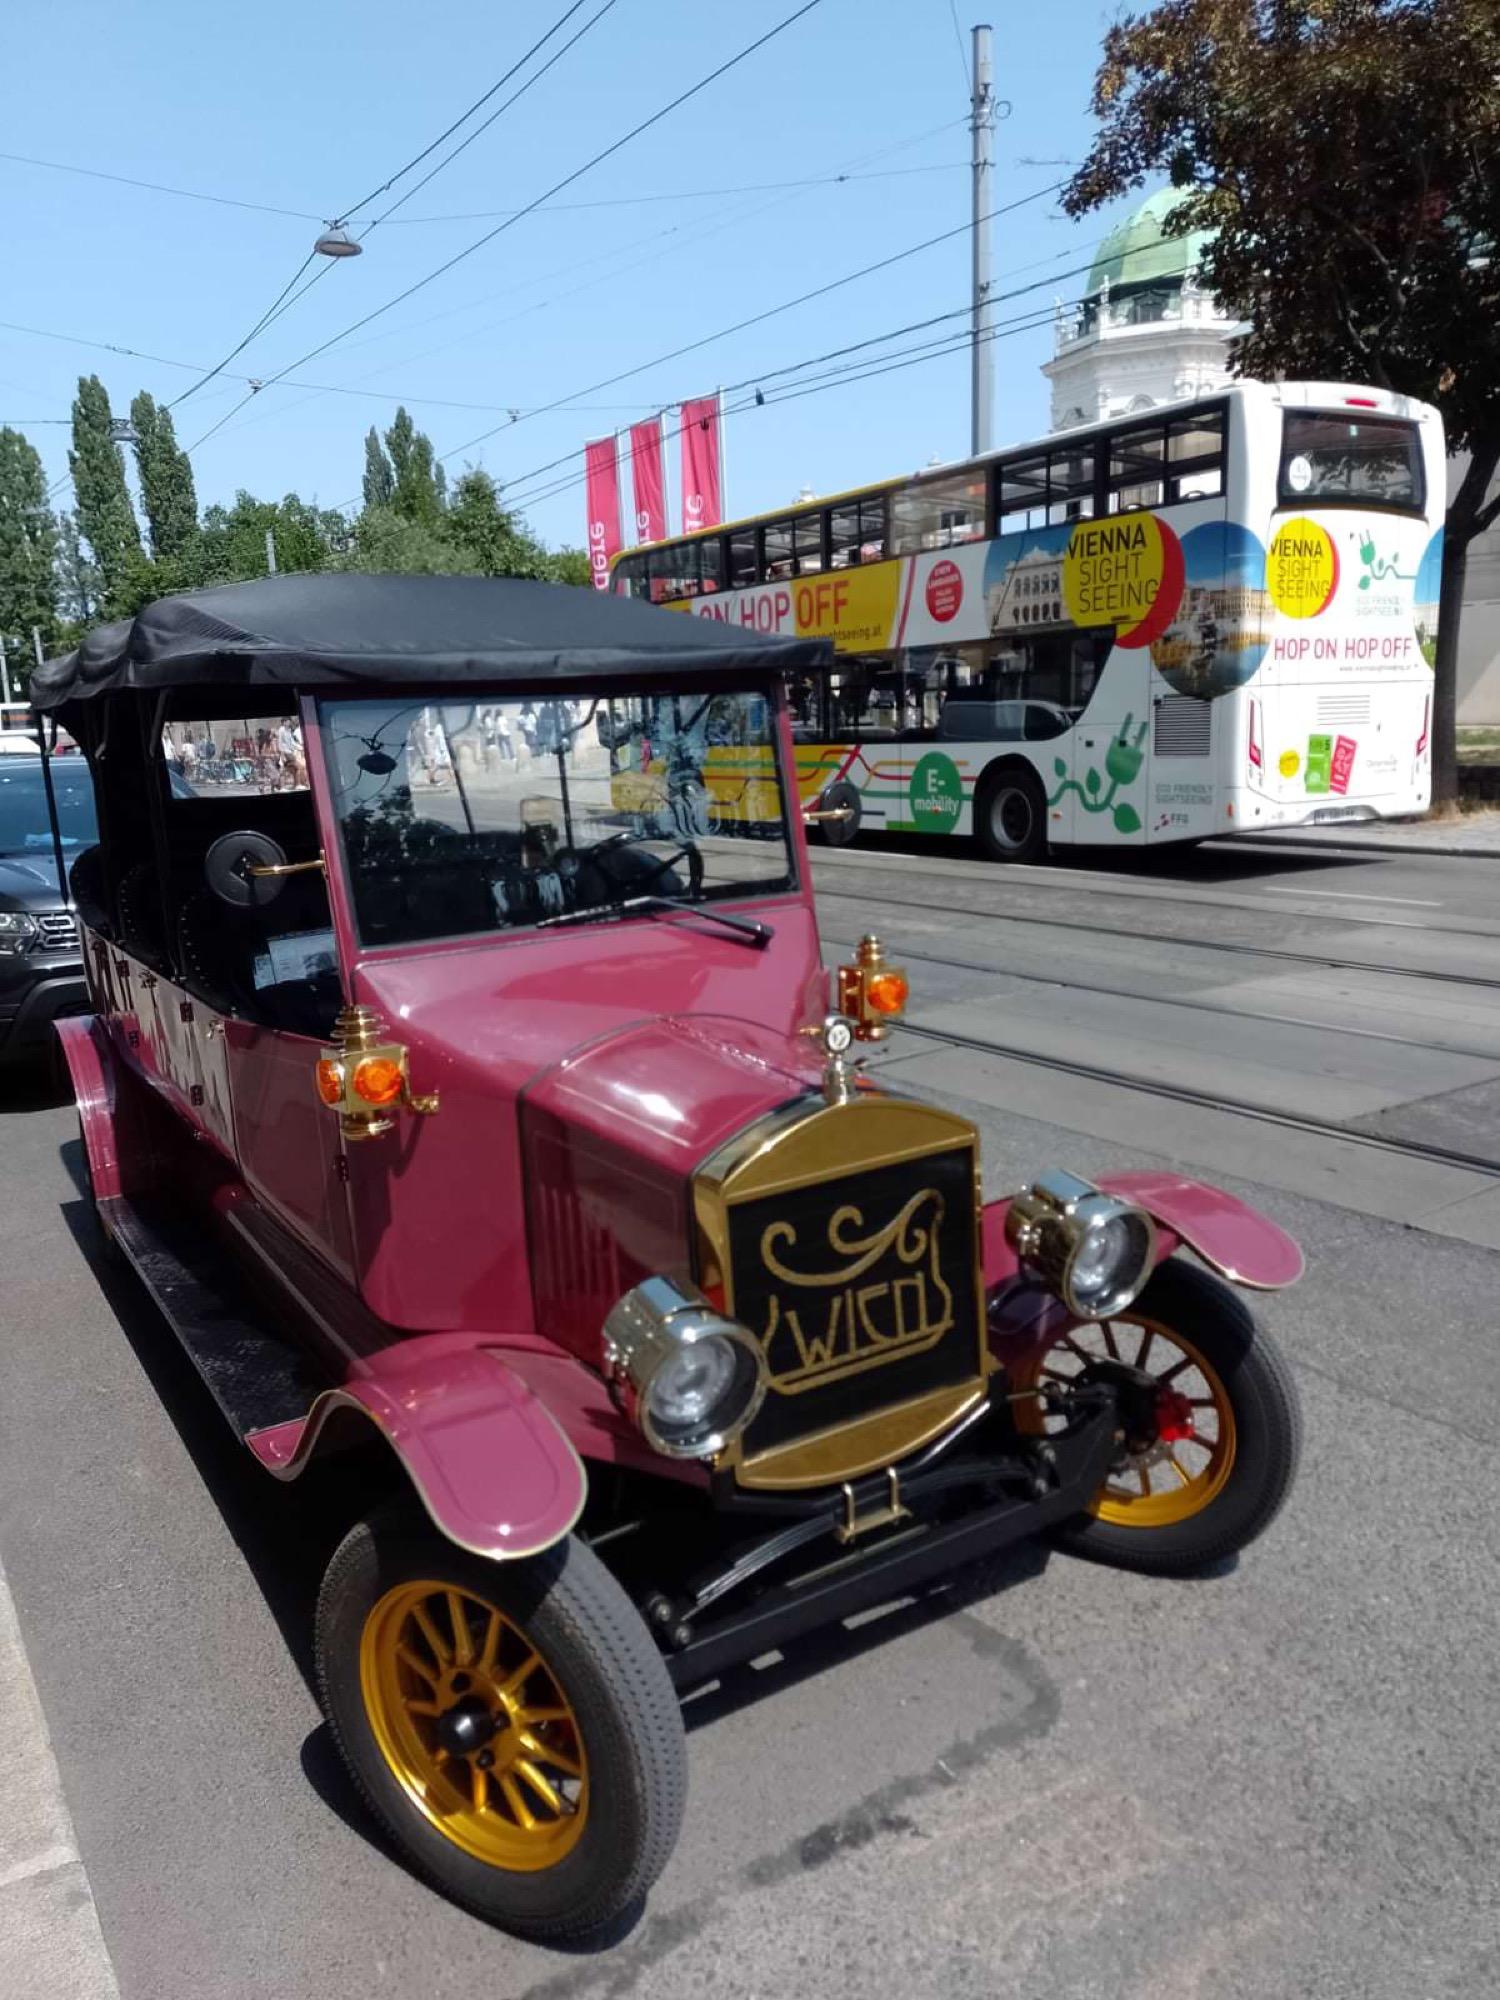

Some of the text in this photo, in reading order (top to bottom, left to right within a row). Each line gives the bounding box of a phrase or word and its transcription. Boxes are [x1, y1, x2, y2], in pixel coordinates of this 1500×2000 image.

[1068, 522, 1146, 560] VIENNA
[1270, 539, 1323, 558] VIENNA
[1080, 551, 1143, 586] SIGHT
[1278, 559, 1321, 579] SIGHT
[1080, 579, 1159, 613] SEEING
[1277, 579, 1330, 599] SEEING
[740, 591, 790, 634] HOP
[796, 580, 849, 629] OFF
[1274, 637, 1412, 660] HOP ON HOP OFF
[927, 768, 946, 792] E-
[914, 795, 959, 816] mobility
